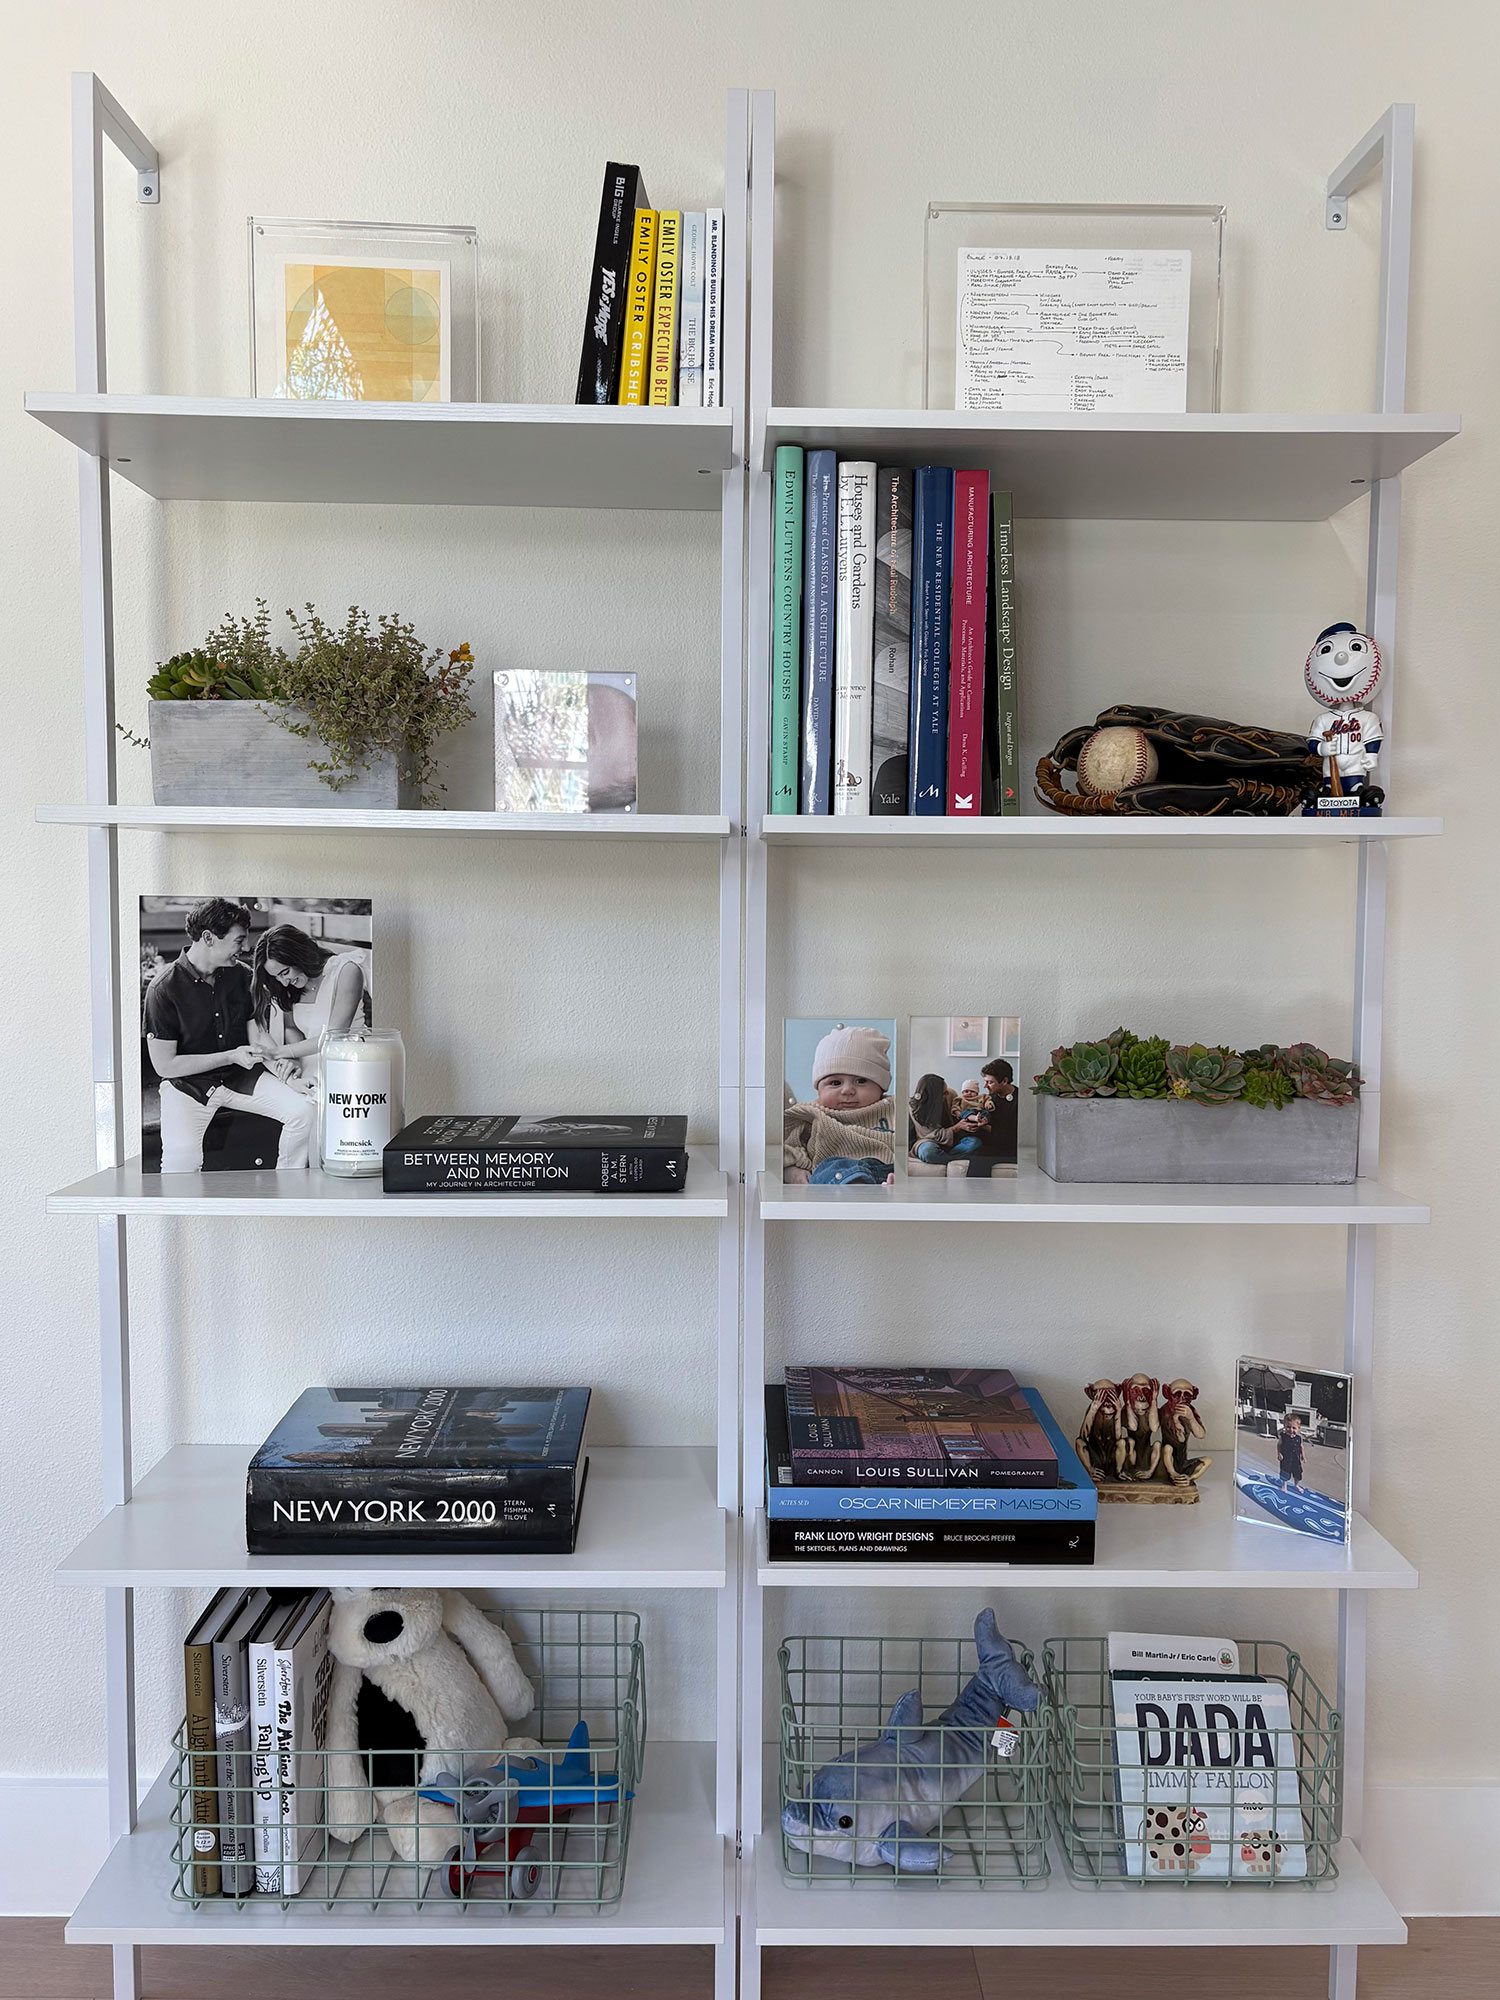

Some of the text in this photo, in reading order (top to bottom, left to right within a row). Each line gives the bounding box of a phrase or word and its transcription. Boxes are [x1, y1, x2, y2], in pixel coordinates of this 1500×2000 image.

[614, 177, 626, 197] BIG
[612, 223, 620, 244] INGELS
[637, 216, 652, 264] EMILY
[661, 219, 677, 255] EMILY
[710, 235, 718, 277] BLANDINGS
[660, 261, 674, 299] OSTER
[633, 272, 648, 322] OSTER
[656, 306, 672, 372] EXPECTING
[688, 318, 696, 336] THE
[687, 353, 696, 384] HOUSE
[784, 470, 796, 514] EDWIN
[839, 475, 854, 491] by
[891, 476, 900, 493] The
[890, 494, 899, 547] Architecture
[784, 520, 796, 581] LUTYENS
[852, 474, 868, 609] Houses and Gardens
[889, 549, 898, 558] of
[965, 486, 975, 605] MANUFACTURING ARCHITECTURE
[838, 528, 853, 582] Lutyens
[935, 546, 943, 568] NEW
[819, 492, 830, 682] Practice of CLASSICAL ARCHITECTURE
[888, 579, 897, 615] Rudolph
[783, 585, 792, 646] COUNTRY
[934, 572, 942, 637] RESIDENTIAL
[999, 520, 1014, 691] Timeless Landscape Design
[888, 647, 897, 673] Rohan
[933, 641, 941, 691] COLLEGES
[782, 651, 791, 700] HOUSES
[932, 694, 940, 708] AT
[1330, 717, 1361, 736] Mets
[1350, 732, 1362, 743] 00
[880, 793, 900, 804] Yale
[1329, 799, 1358, 807] TOYOTA
[329, 1093, 387, 1105] NEW YORK
[343, 1107, 370, 1119] CITY
[339, 1139, 373, 1147] homesick
[403, 1152, 555, 1166] BETWEEN MEMORY
[601, 1151, 610, 1187] ROBERT
[610, 1159, 618, 1180] A. M.
[619, 1154, 627, 1184] STERN
[446, 1166, 569, 1179] AND INVENTION
[483, 1180, 536, 1188] ARCHITECTURE
[421, 1389, 449, 1407] 2000
[407, 1408, 439, 1434] YORK
[819, 1417, 833, 1448] SULLIVAN
[394, 1435, 425, 1458] NEW
[856, 1466, 900, 1478] LOUIS
[906, 1467, 979, 1478] SULLIVAN
[273, 1500, 496, 1522] NEW YORK 2000
[839, 1497, 901, 1510] OSCAR
[903, 1498, 997, 1511] NIEMEYER
[1000, 1498, 1082, 1511] MAISONS
[794, 1531, 1016, 1542] FRANK LLOYD WRIGHT DESIGNS BRUCE BROOKS PFEIFFER
[806, 1545, 838, 1553] SKETCHES,
[1145, 1651, 1168, 1660] Martin
[1181, 1653, 1196, 1661] Eric
[1196, 1654, 1217, 1662] Carle
[192, 1652, 203, 1697] Silverstein
[257, 1658, 268, 1707] Silverstein
[1134, 1693, 1156, 1701] YOUR
[1156, 1693, 1183, 1702] BABY'S
[1184, 1694, 1205, 1702] FIRST
[1206, 1694, 1231, 1702] WORD
[1232, 1694, 1251, 1702] WILL
[192, 1714, 208, 1725] A
[221, 1654, 233, 1782] Silverstein the
[278, 1700, 293, 1724] The
[1135, 1703, 1276, 1767] DADA
[193, 1795, 211, 1824] Attic
